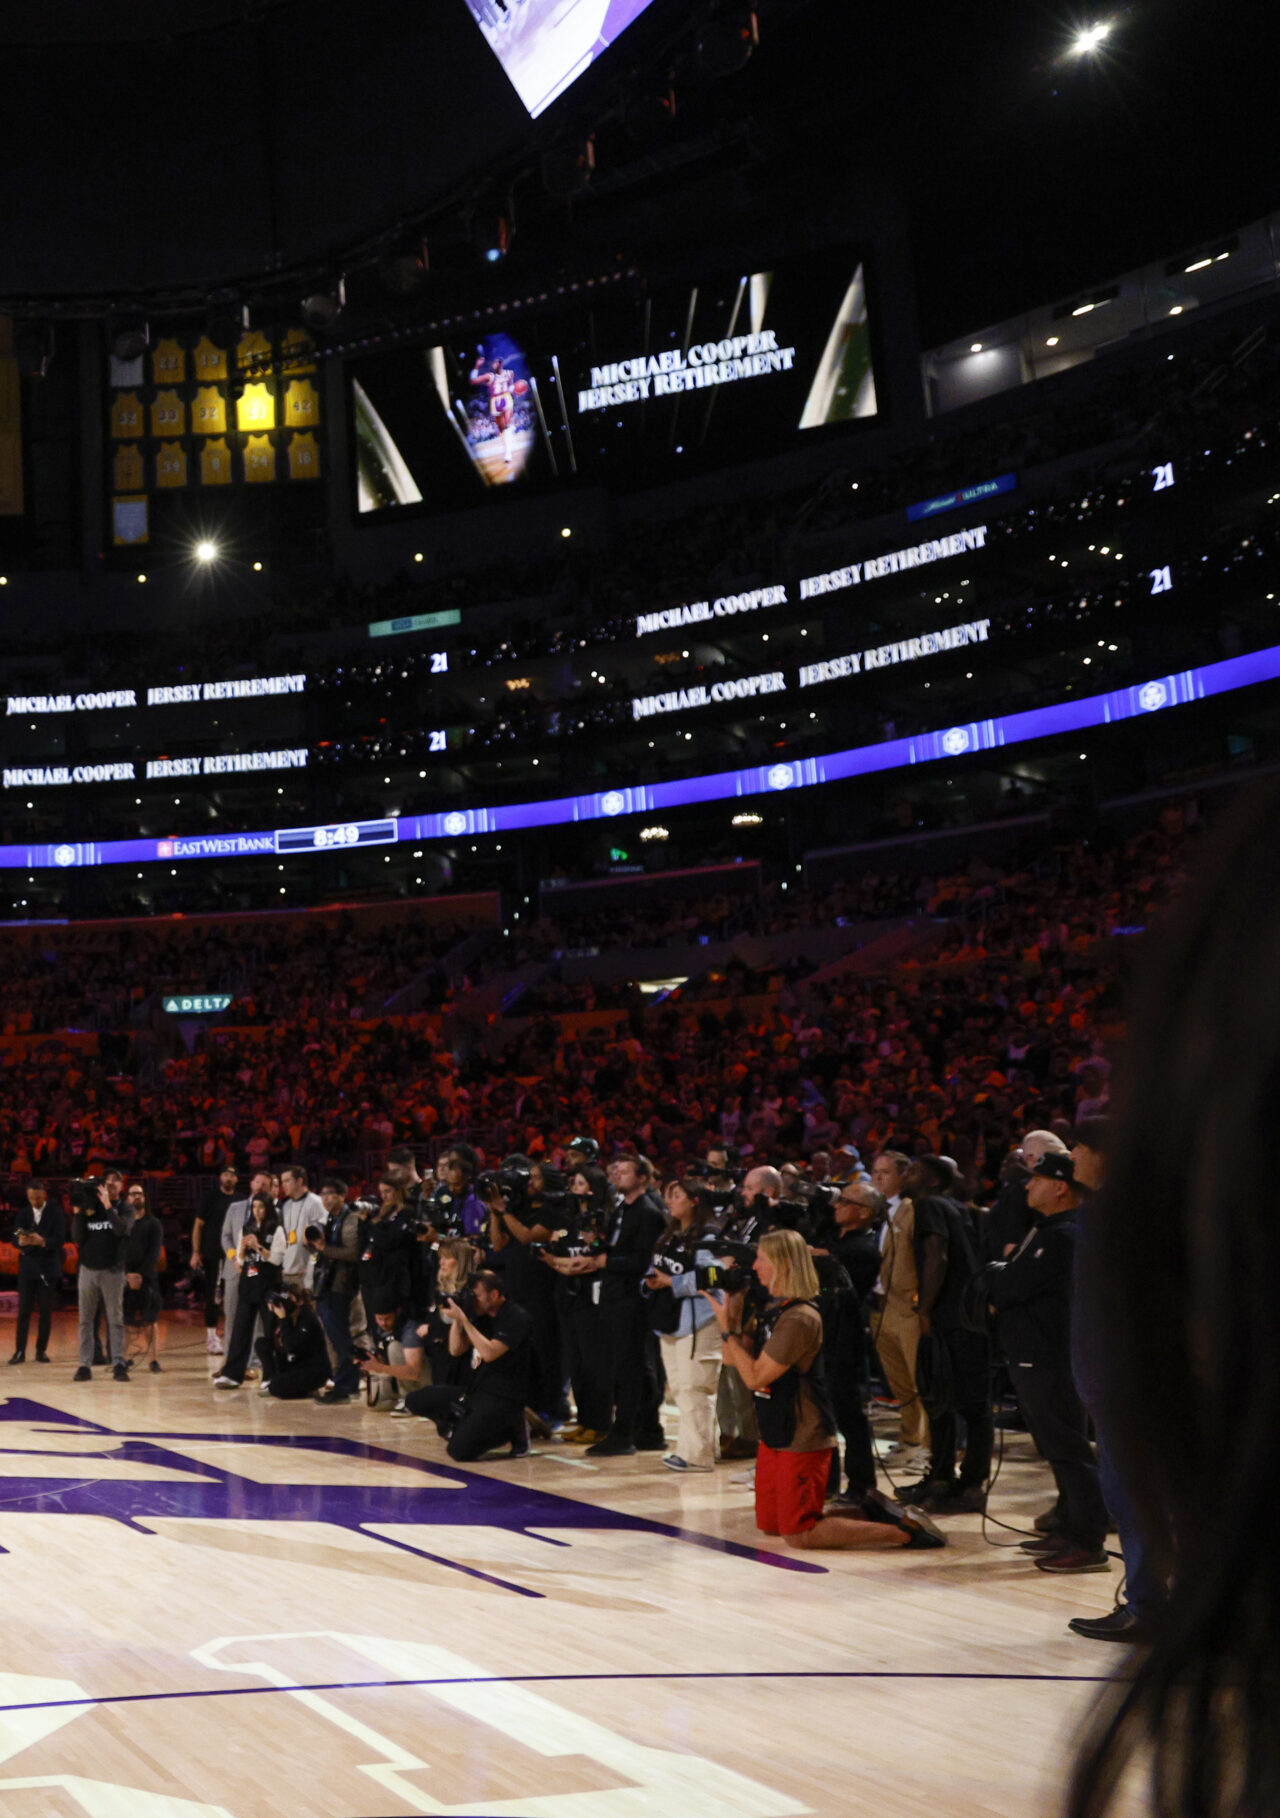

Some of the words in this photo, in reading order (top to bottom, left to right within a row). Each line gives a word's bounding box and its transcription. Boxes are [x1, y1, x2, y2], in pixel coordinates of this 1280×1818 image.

[590, 349, 687, 388] MICHAEL
[687, 329, 778, 367] COOPER
[577, 376, 652, 413] JERSEY
[653, 346, 796, 397] RETIREMENT
[293, 399, 313, 412] 42
[1152, 461, 1175, 492] 21
[636, 602, 714, 636] MICHAEL
[713, 585, 788, 616] COOPER
[799, 562, 863, 600] JERSEY
[863, 525, 988, 580] RETIREMENT
[1149, 565, 1173, 595] 21
[429, 651, 449, 673] 21
[632, 686, 711, 720] MICHAEL
[710, 671, 786, 703] COOPER
[798, 653, 863, 687] JERSEY
[863, 618, 990, 672] RETIREMENT
[7, 695, 76, 714] MICHAEL
[75, 690, 137, 710] COOPER
[147, 684, 204, 706] JERSEY
[203, 674, 307, 700] RETIREMENT
[428, 730, 448, 752] 21
[2, 768, 72, 787] MICHAEL
[72, 762, 135, 783] COOPER
[146, 757, 202, 779] JERSEY
[203, 749, 308, 774] RETIREMENT
